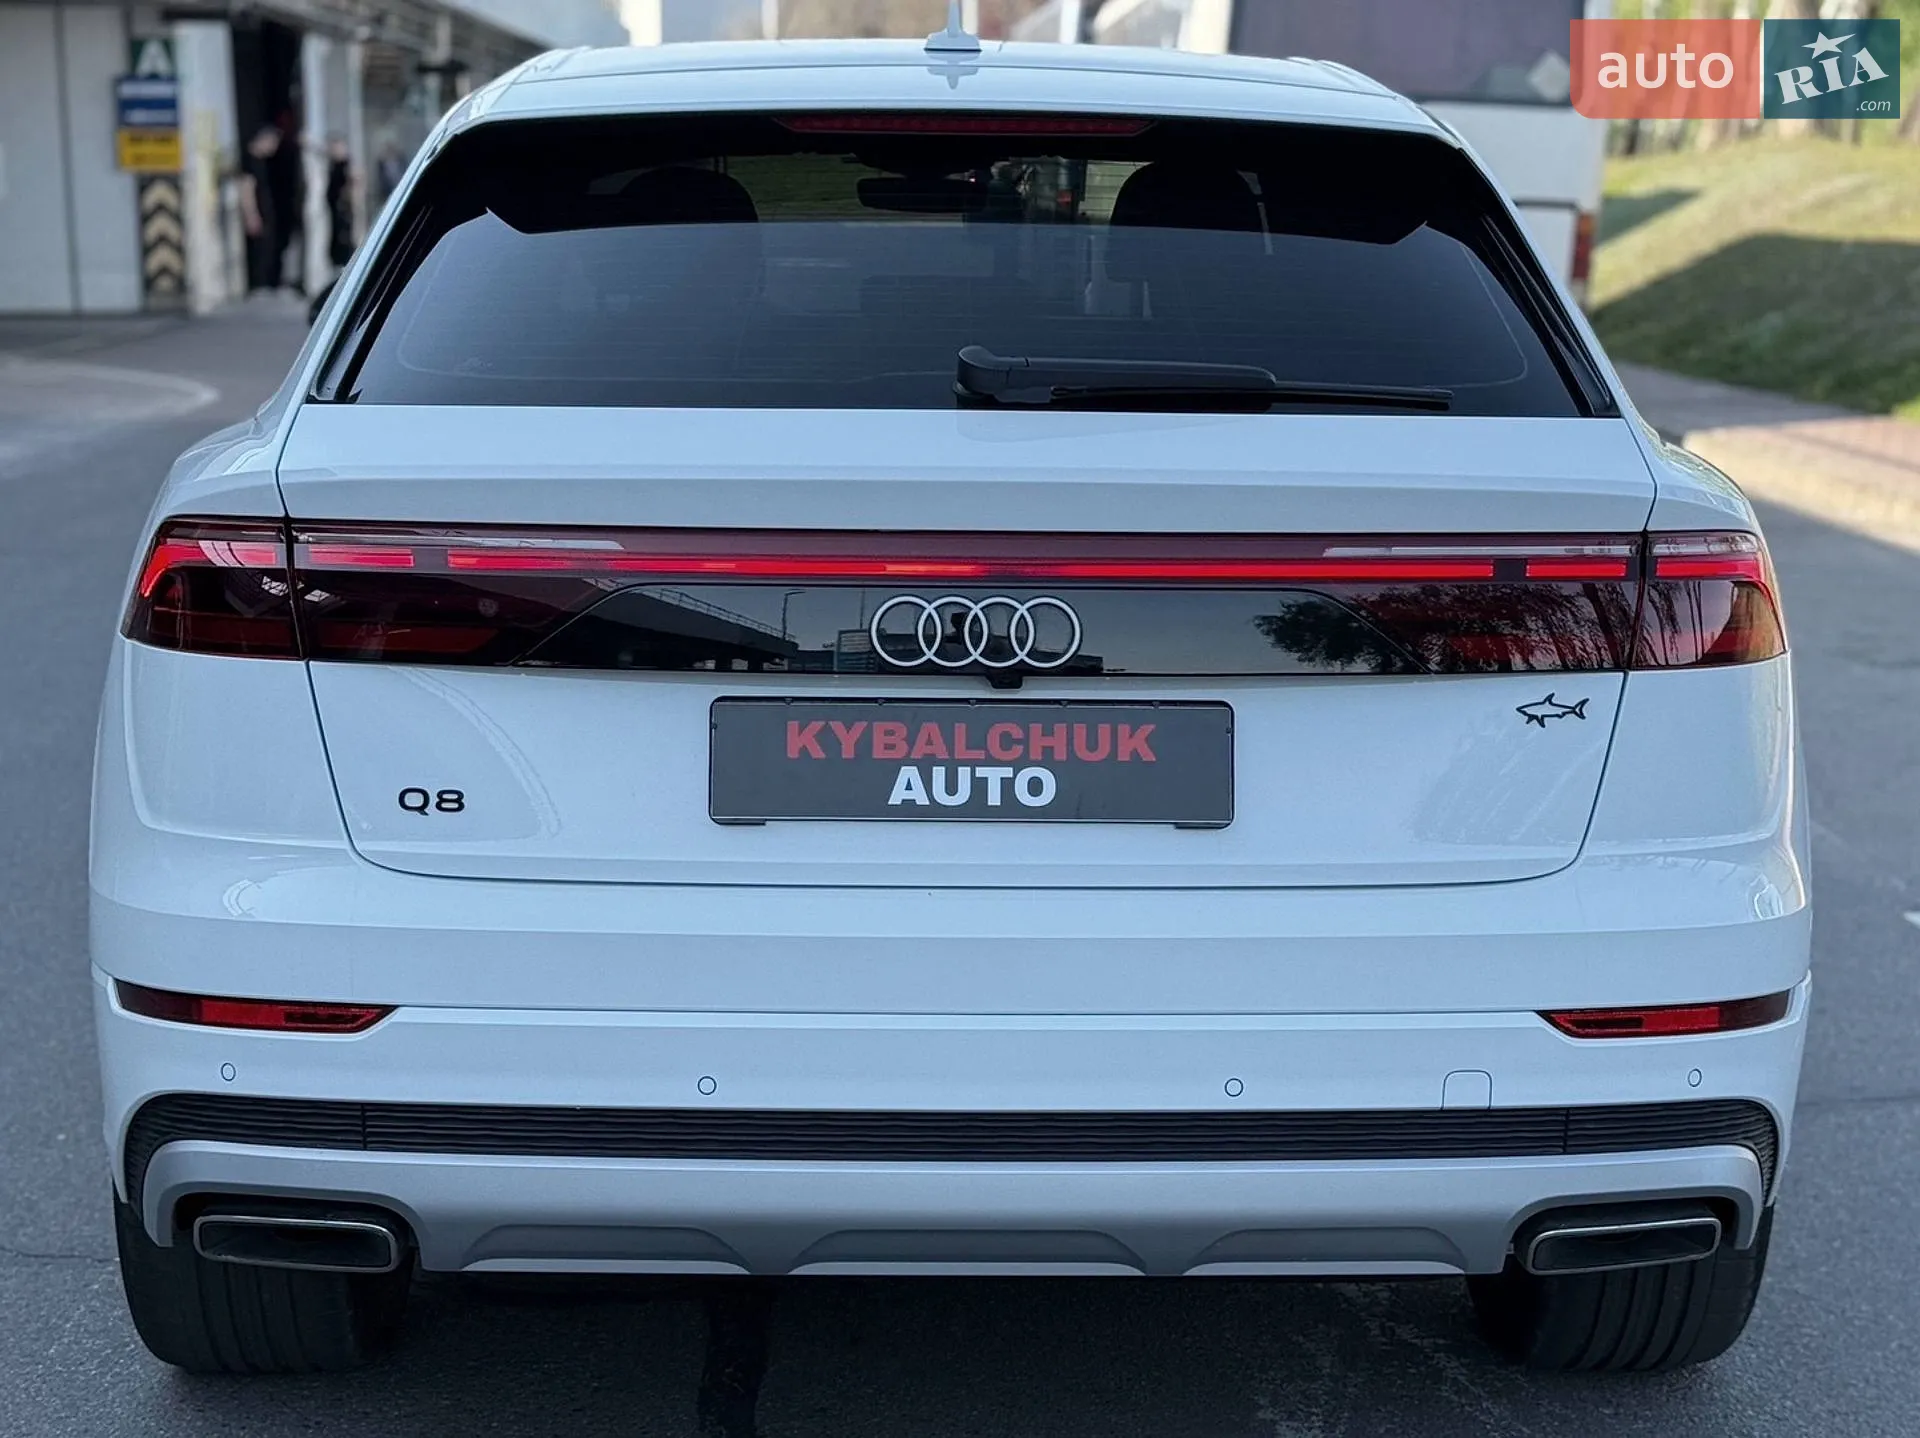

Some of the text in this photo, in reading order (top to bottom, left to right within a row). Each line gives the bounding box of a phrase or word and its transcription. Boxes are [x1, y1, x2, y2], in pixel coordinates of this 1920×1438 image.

[134, 39, 175, 77] A
[786, 721, 1156, 762] KYBALCHUK
[398, 787, 465, 816] Q8
[887, 765, 1057, 807] AUTO
